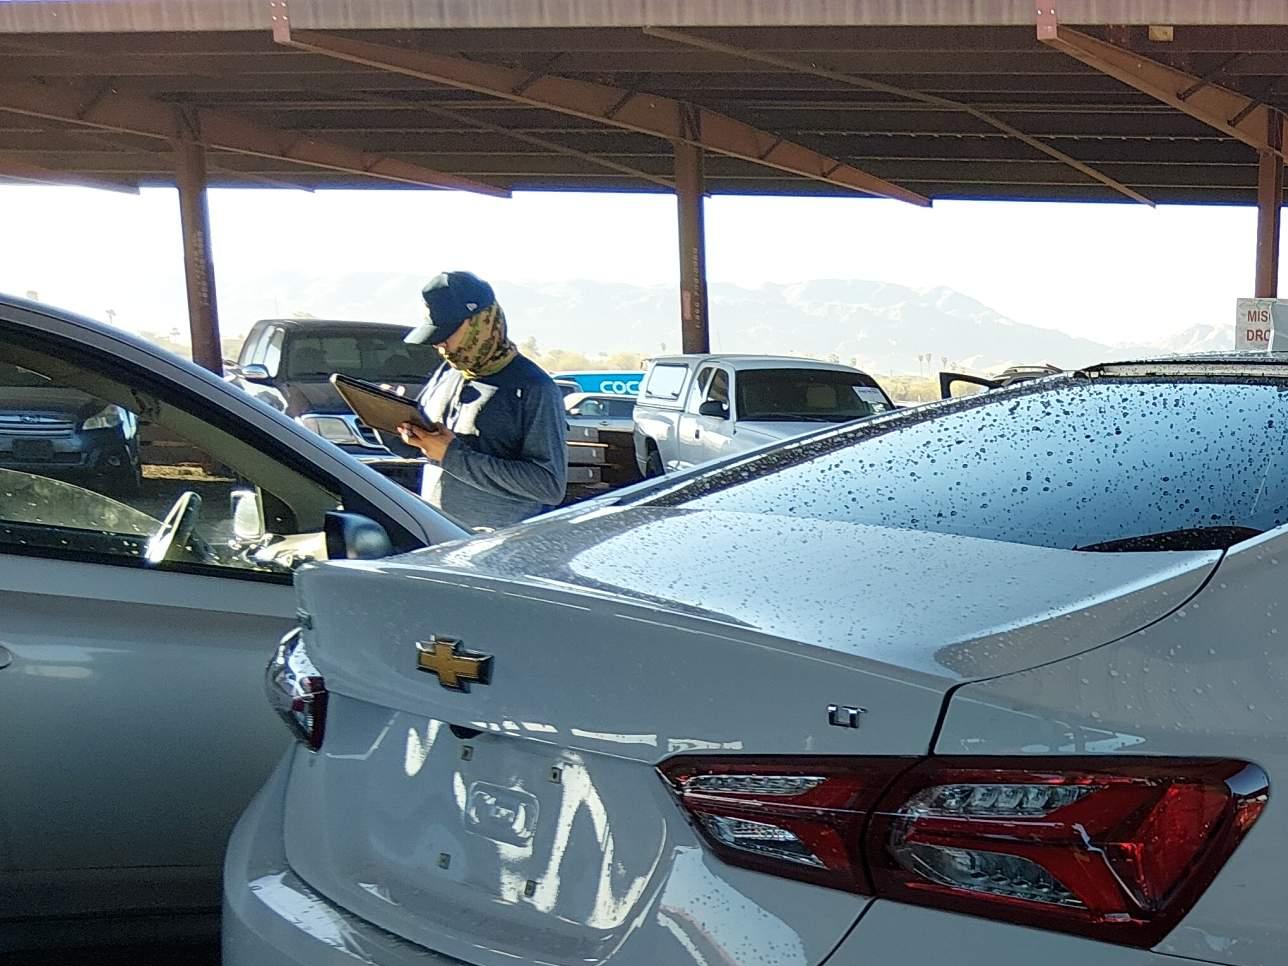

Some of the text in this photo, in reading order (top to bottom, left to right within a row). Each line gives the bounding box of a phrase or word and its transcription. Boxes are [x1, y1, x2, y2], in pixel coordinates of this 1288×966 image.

[1247, 310, 1270, 323] MIS
[599, 380, 640, 394] COC
[827, 703, 868, 729] LT
